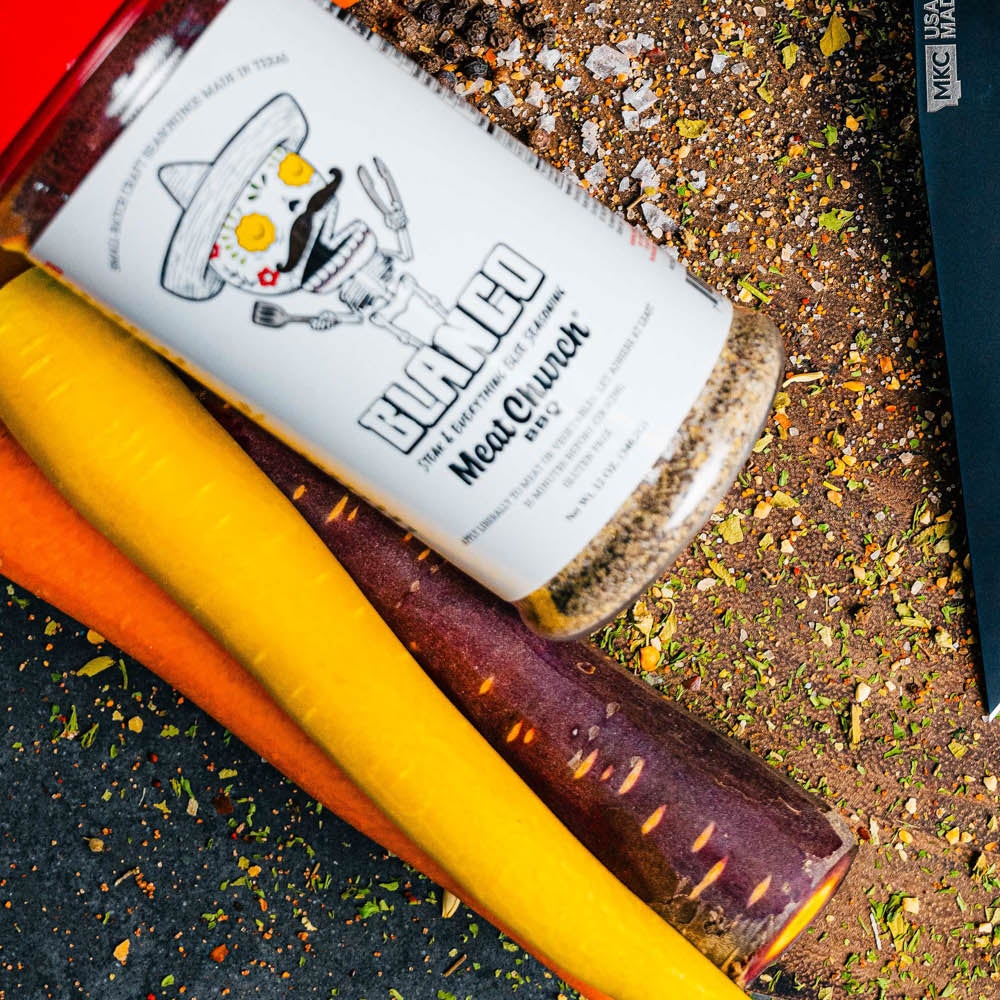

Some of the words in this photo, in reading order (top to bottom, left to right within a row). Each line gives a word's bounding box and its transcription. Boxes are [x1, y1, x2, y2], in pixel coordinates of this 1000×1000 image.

[924, 0, 939, 40] USA
[931, 51, 952, 100] MKC
[357, 242, 546, 455] BLANCO
[449, 419, 517, 486] Meat
[503, 321, 591, 424] Church
[524, 400, 562, 442] BBQ
